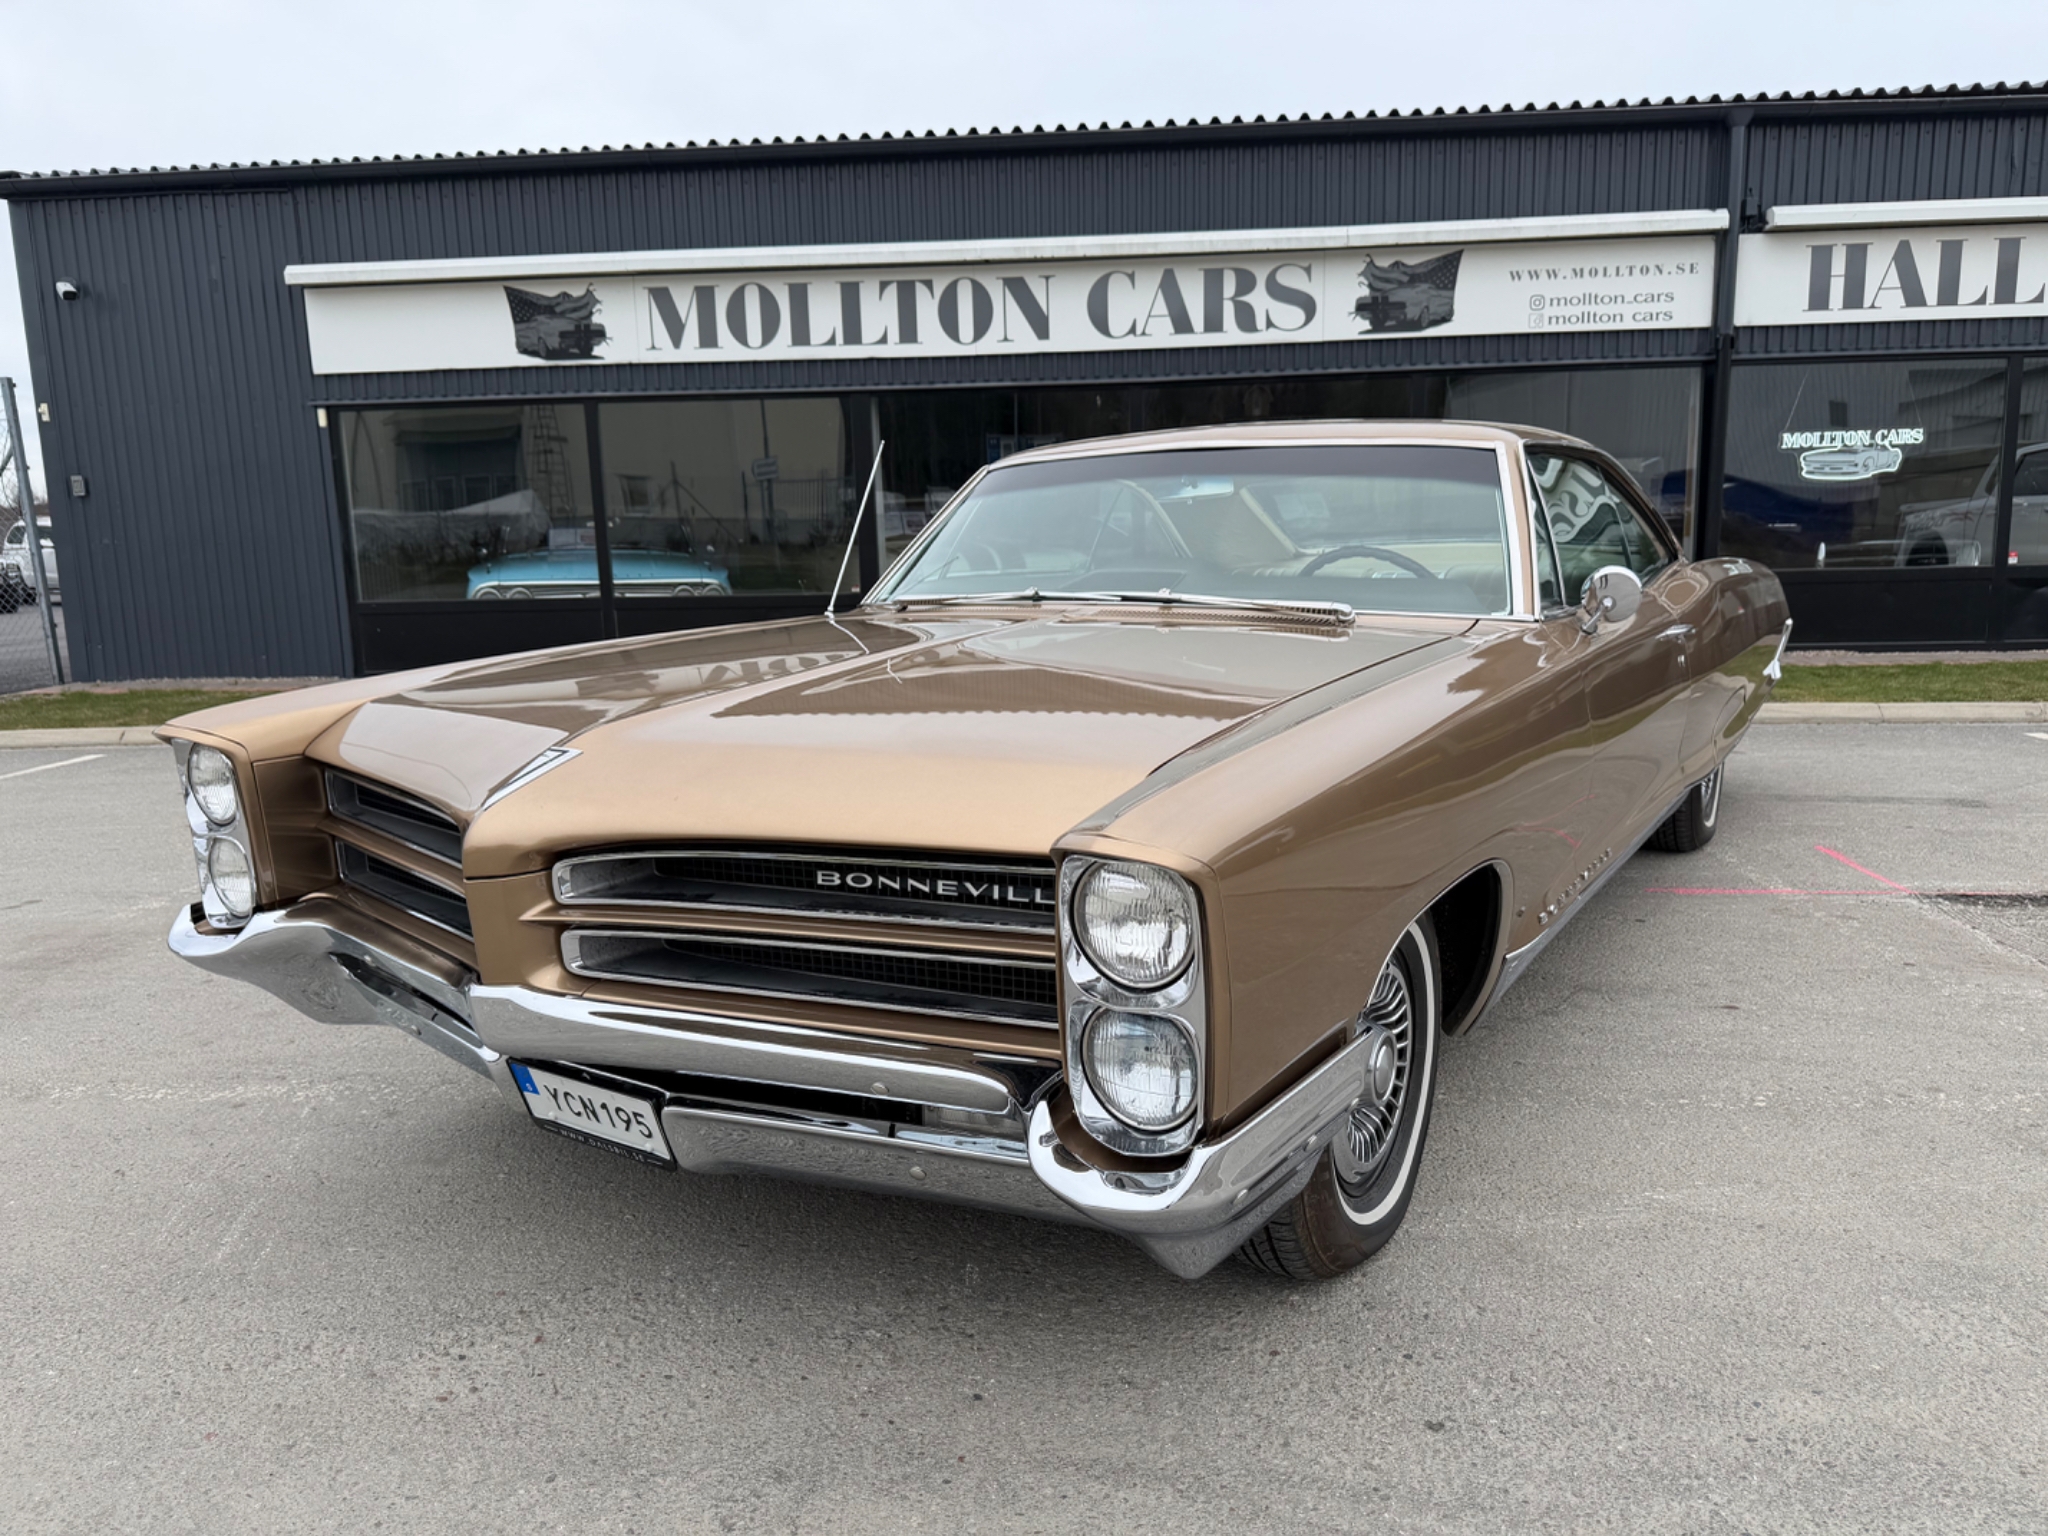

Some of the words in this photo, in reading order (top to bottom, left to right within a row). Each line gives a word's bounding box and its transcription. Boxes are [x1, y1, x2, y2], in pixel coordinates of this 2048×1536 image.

[1508, 261, 1700, 283] WWW.MOLLTON.SE
[1802, 236, 2046, 312] HALL
[643, 275, 1056, 351] MOLLTON
[1086, 263, 1318, 340] CARS
[1548, 291, 1675, 308] mollton_cars
[1547, 310, 1624, 326] mollton
[1631, 310, 1674, 323] cars
[1781, 430, 1872, 449] MOLLTON
[1875, 428, 1924, 445] CARS
[816, 870, 1056, 904] BONNEVILL
[543, 1084, 653, 1139] YCN195
